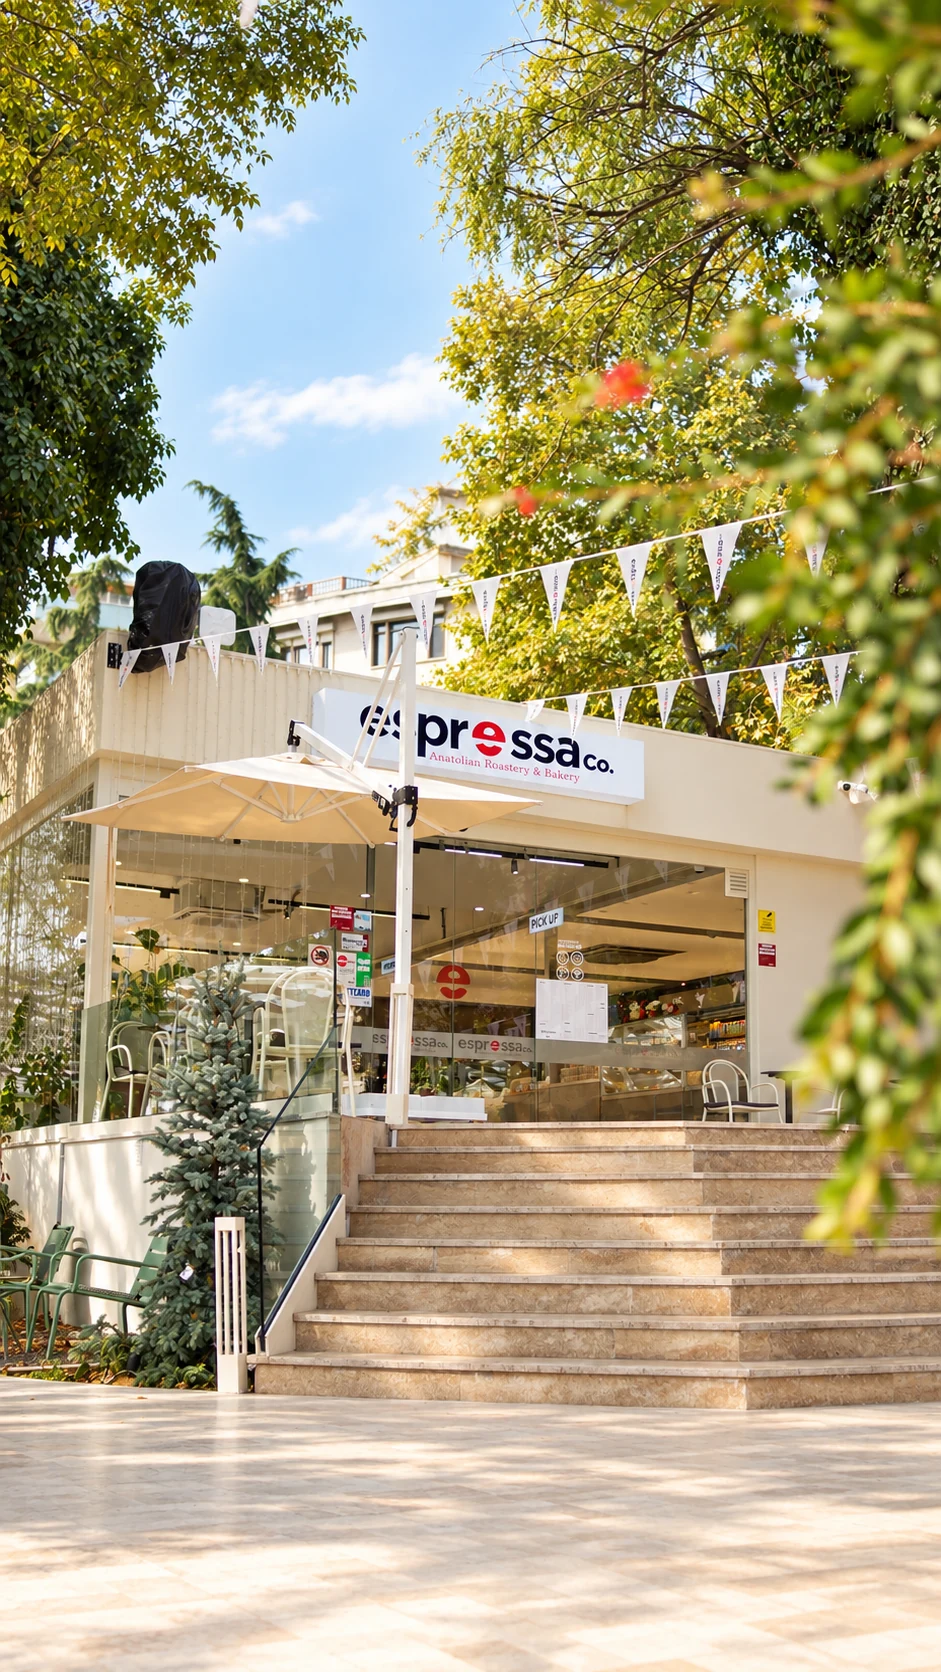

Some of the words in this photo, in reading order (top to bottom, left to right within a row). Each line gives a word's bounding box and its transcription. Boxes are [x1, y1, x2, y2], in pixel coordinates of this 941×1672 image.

[429, 751, 481, 768] Anatolian
[485, 759, 530, 777] Roastery
[533, 766, 541, 777] &
[544, 769, 580, 784] Bakery
[531, 914, 547, 930] PICK
[548, 912, 559, 925] UP
[458, 1038, 522, 1053] espressa
